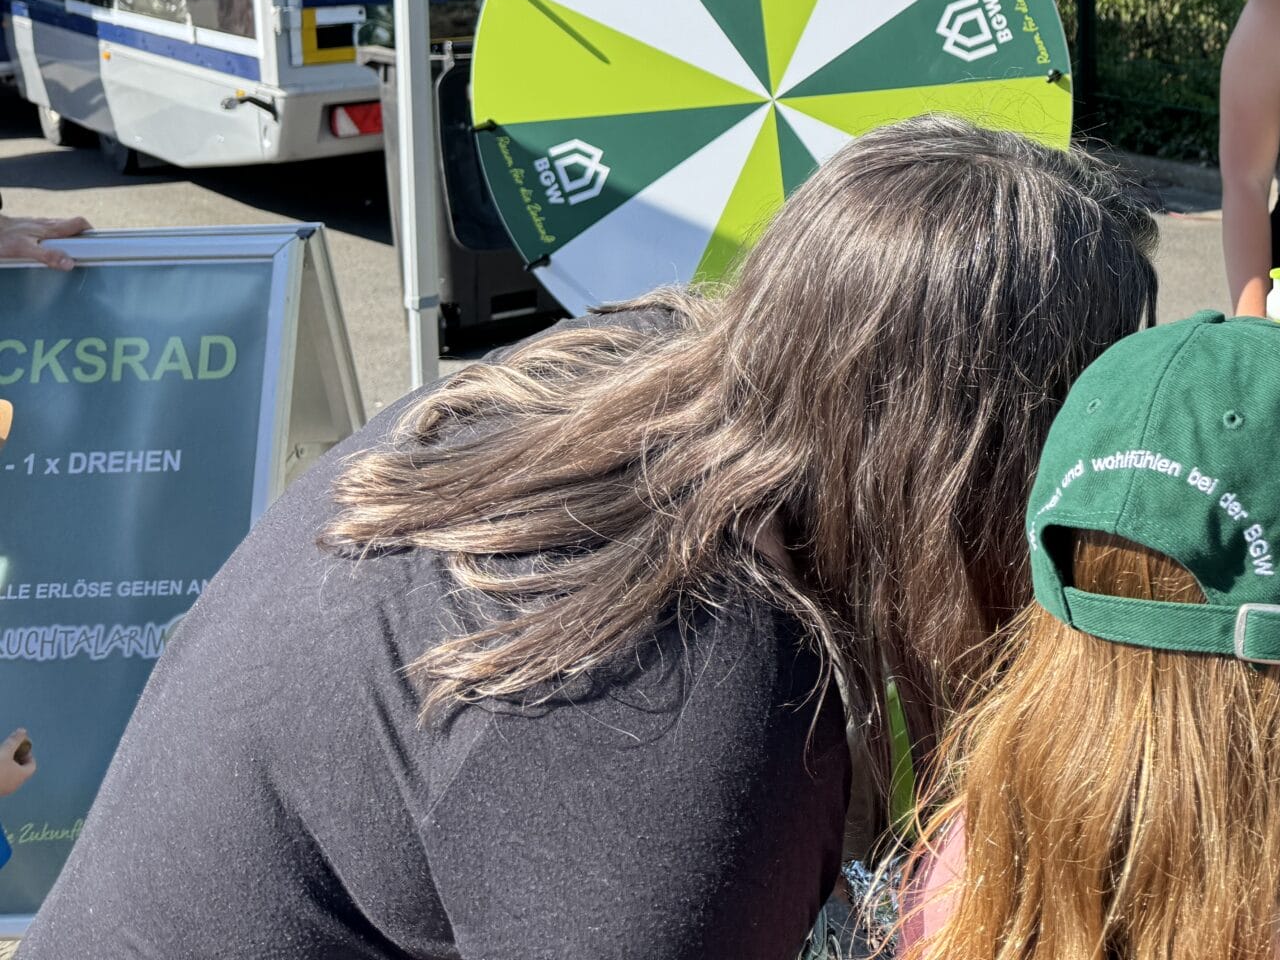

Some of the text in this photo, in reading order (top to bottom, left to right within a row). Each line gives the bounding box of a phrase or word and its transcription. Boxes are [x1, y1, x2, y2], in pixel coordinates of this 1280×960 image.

[533, 157, 565, 205] BGW
[24, 452, 36, 475] 1
[44, 456, 61, 475] x
[67, 449, 182, 474] DREHEN
[1092, 450, 1182, 477] wohlfühlen
[1186, 467, 1219, 495] bei
[1219, 492, 1249, 521] der
[1243, 523, 1276, 576] BGW
[36, 579, 113, 599] ERLÖSE
[117, 580, 183, 597] GEHEN
[0, 623, 168, 658] UCHTALARM
